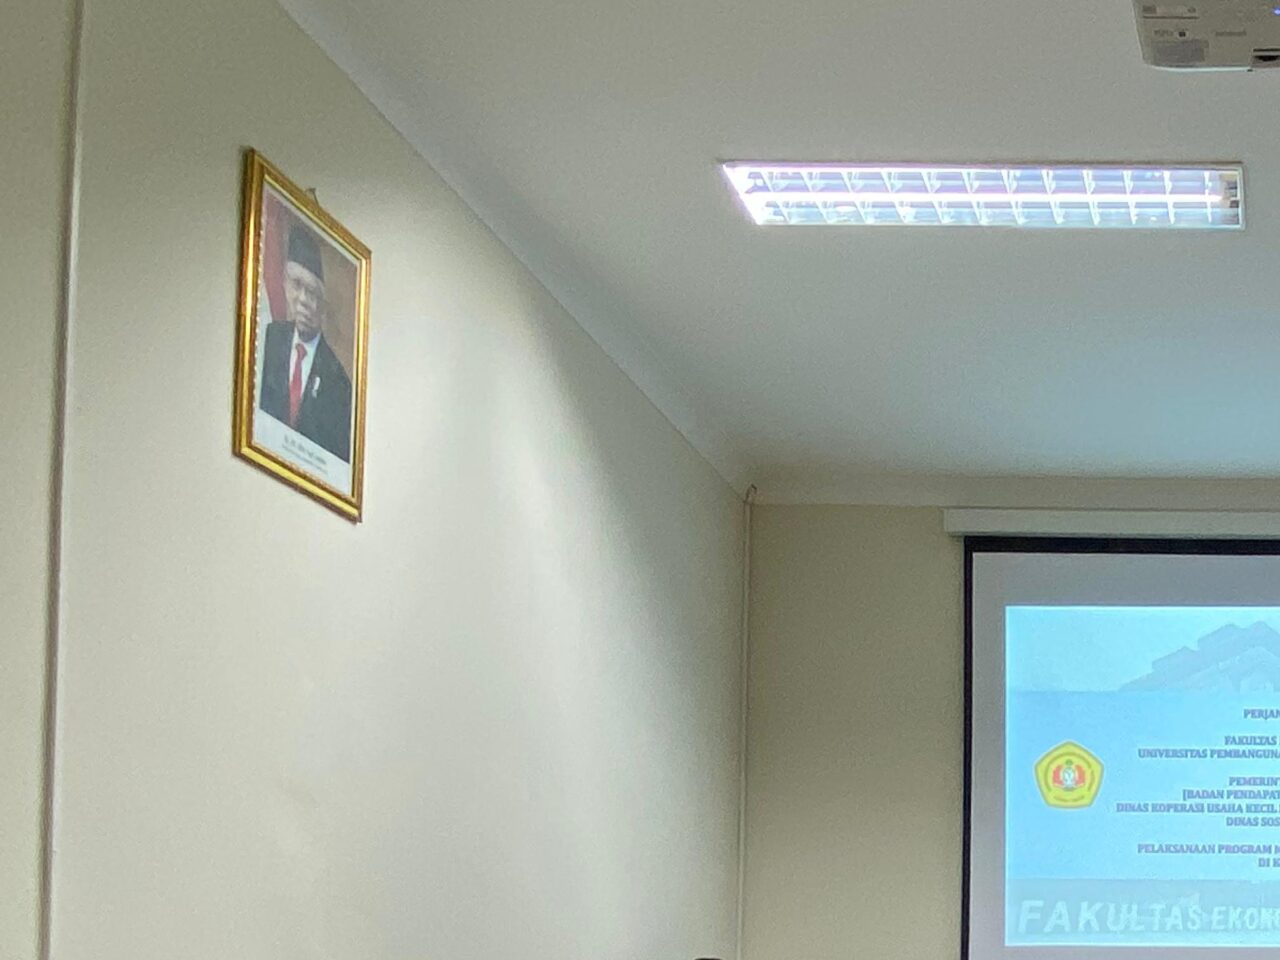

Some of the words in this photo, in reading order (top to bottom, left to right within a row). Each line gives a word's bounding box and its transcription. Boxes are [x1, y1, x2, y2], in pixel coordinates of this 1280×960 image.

[1224, 736, 1278, 746] FAKULTAS
[1138, 749, 1208, 758] UNIVERSITAS
[1116, 803, 1149, 813] DINAS
[1151, 803, 1205, 813] KOPERASI
[1207, 804, 1243, 813] USAHA
[1246, 804, 1277, 813] KECIL
[1226, 817, 1259, 826] DINAS
[1137, 844, 1216, 854] PELAKSANAAN
[1218, 844, 1272, 854] PROGRAM
[1258, 858, 1270, 868] DI
[1015, 900, 1201, 934] FAKULTAS
